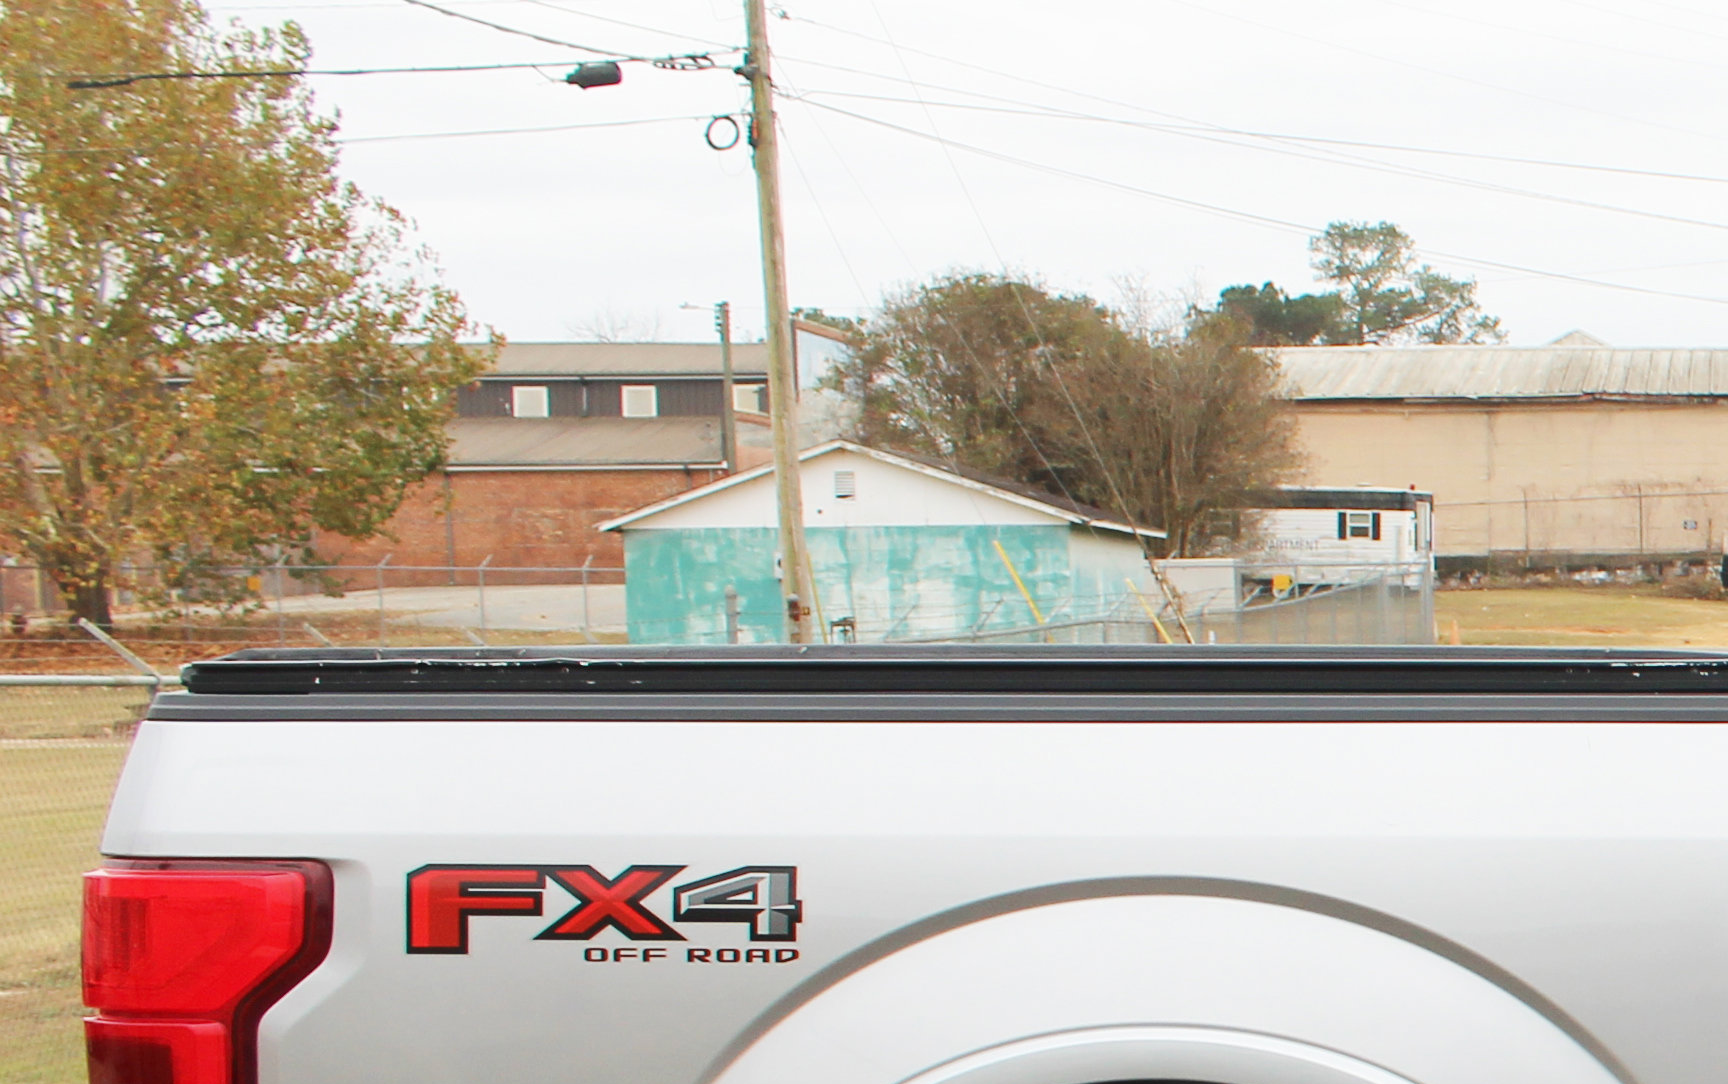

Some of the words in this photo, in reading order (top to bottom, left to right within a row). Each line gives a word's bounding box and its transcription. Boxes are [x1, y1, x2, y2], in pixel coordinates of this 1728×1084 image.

[407, 864, 802, 954] FX4
[584, 948, 667, 962] OFF
[687, 948, 800, 962] ROAD
